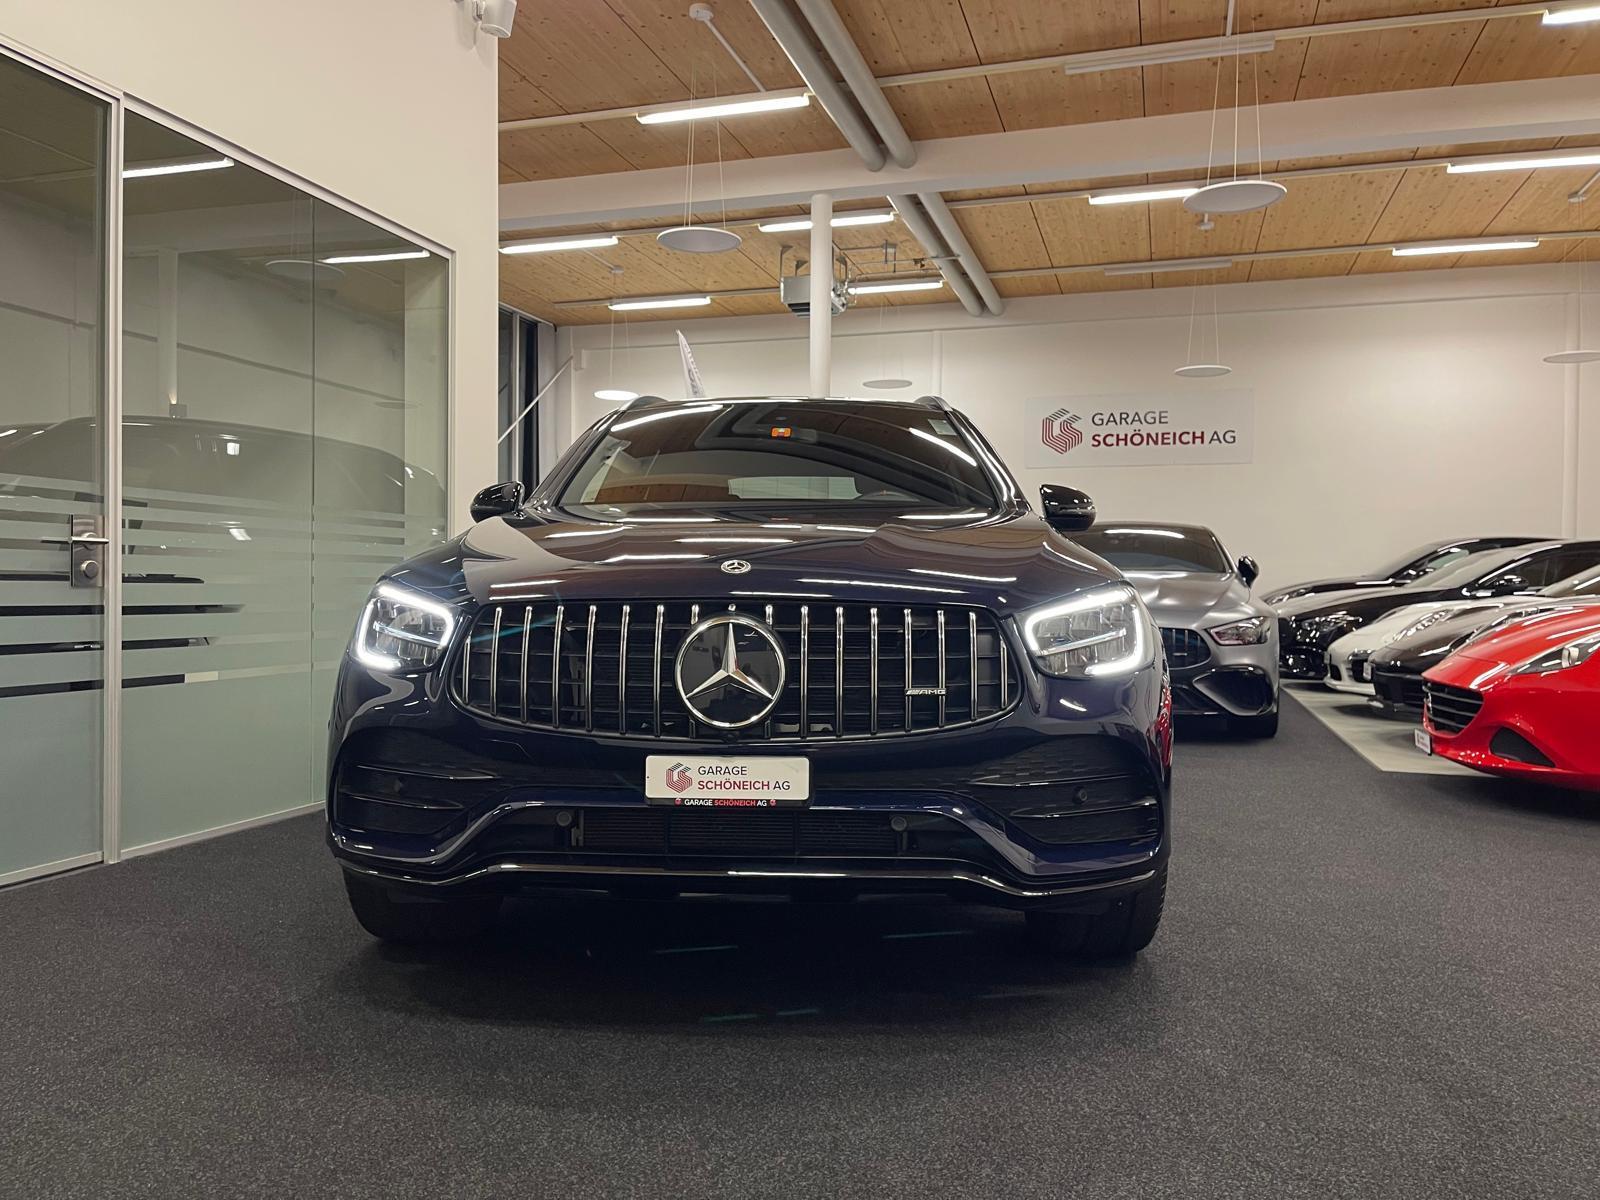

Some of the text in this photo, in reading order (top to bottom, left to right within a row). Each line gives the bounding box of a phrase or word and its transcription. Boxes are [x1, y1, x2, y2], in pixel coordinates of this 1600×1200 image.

[1091, 410, 1169, 426] GARAGE
[1091, 429, 1236, 448] SCHÖNEICH AG
[698, 766, 747, 776] GARAGE
[698, 778, 791, 791] SCHÖNEICH AG
[714, 798, 756, 807] SCHÖNEICH
[756, 799, 767, 807] AG
